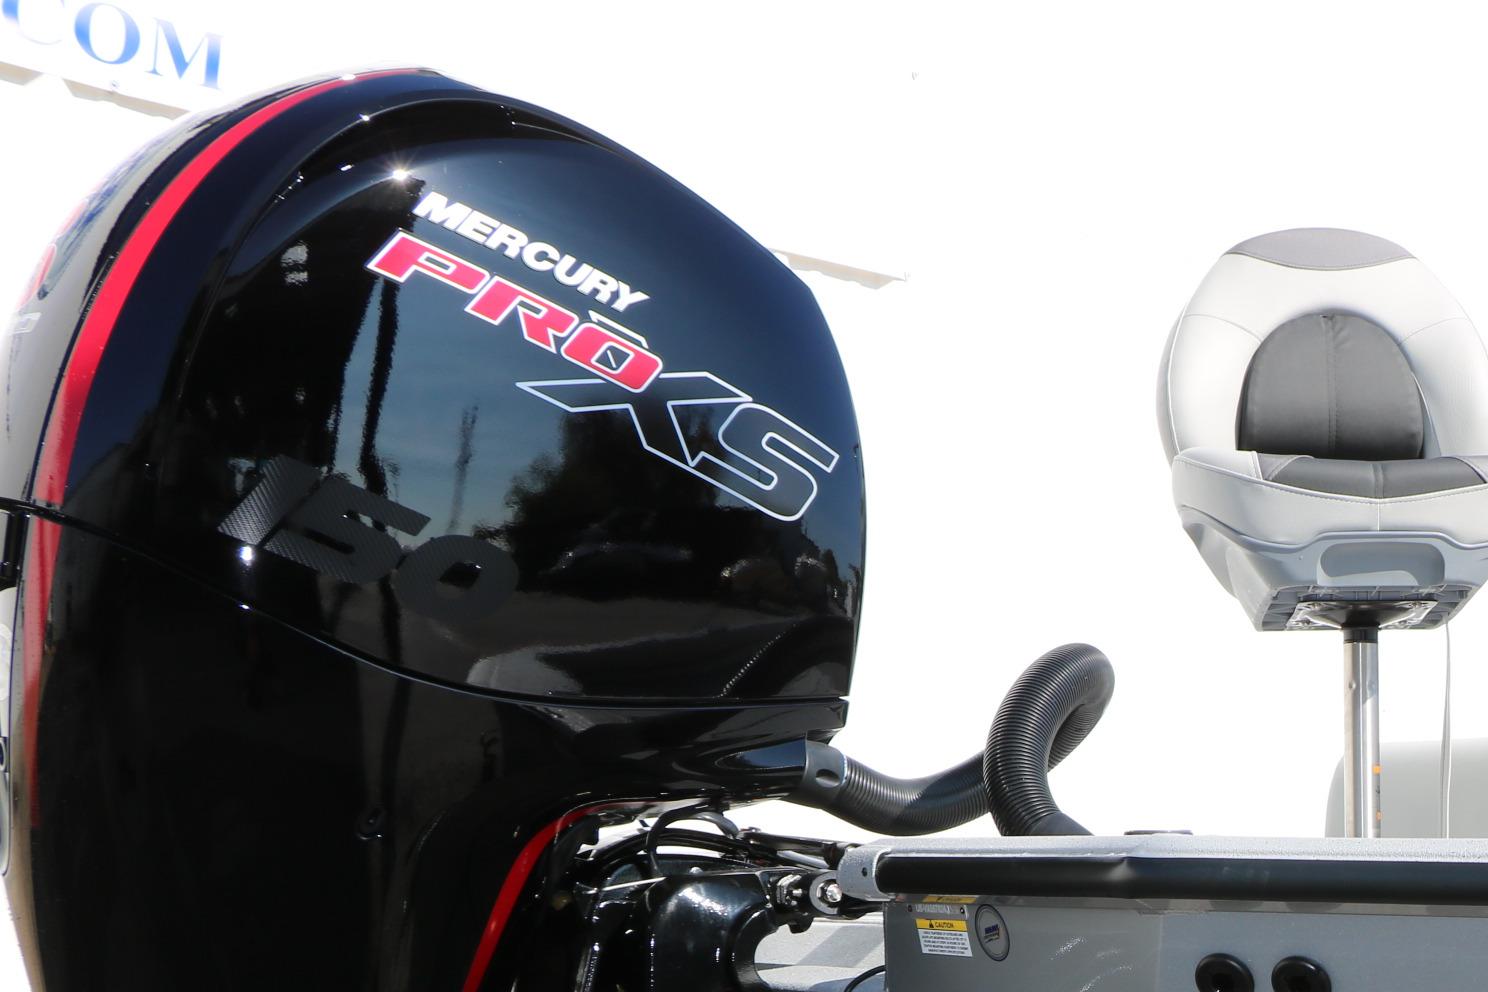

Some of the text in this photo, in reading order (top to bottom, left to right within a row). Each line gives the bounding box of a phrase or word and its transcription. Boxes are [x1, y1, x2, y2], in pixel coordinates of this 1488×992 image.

[365, 228, 664, 393] PRO
[413, 191, 651, 313] MERCURY
[515, 370, 840, 522] XS
[217, 453, 520, 620] 150
